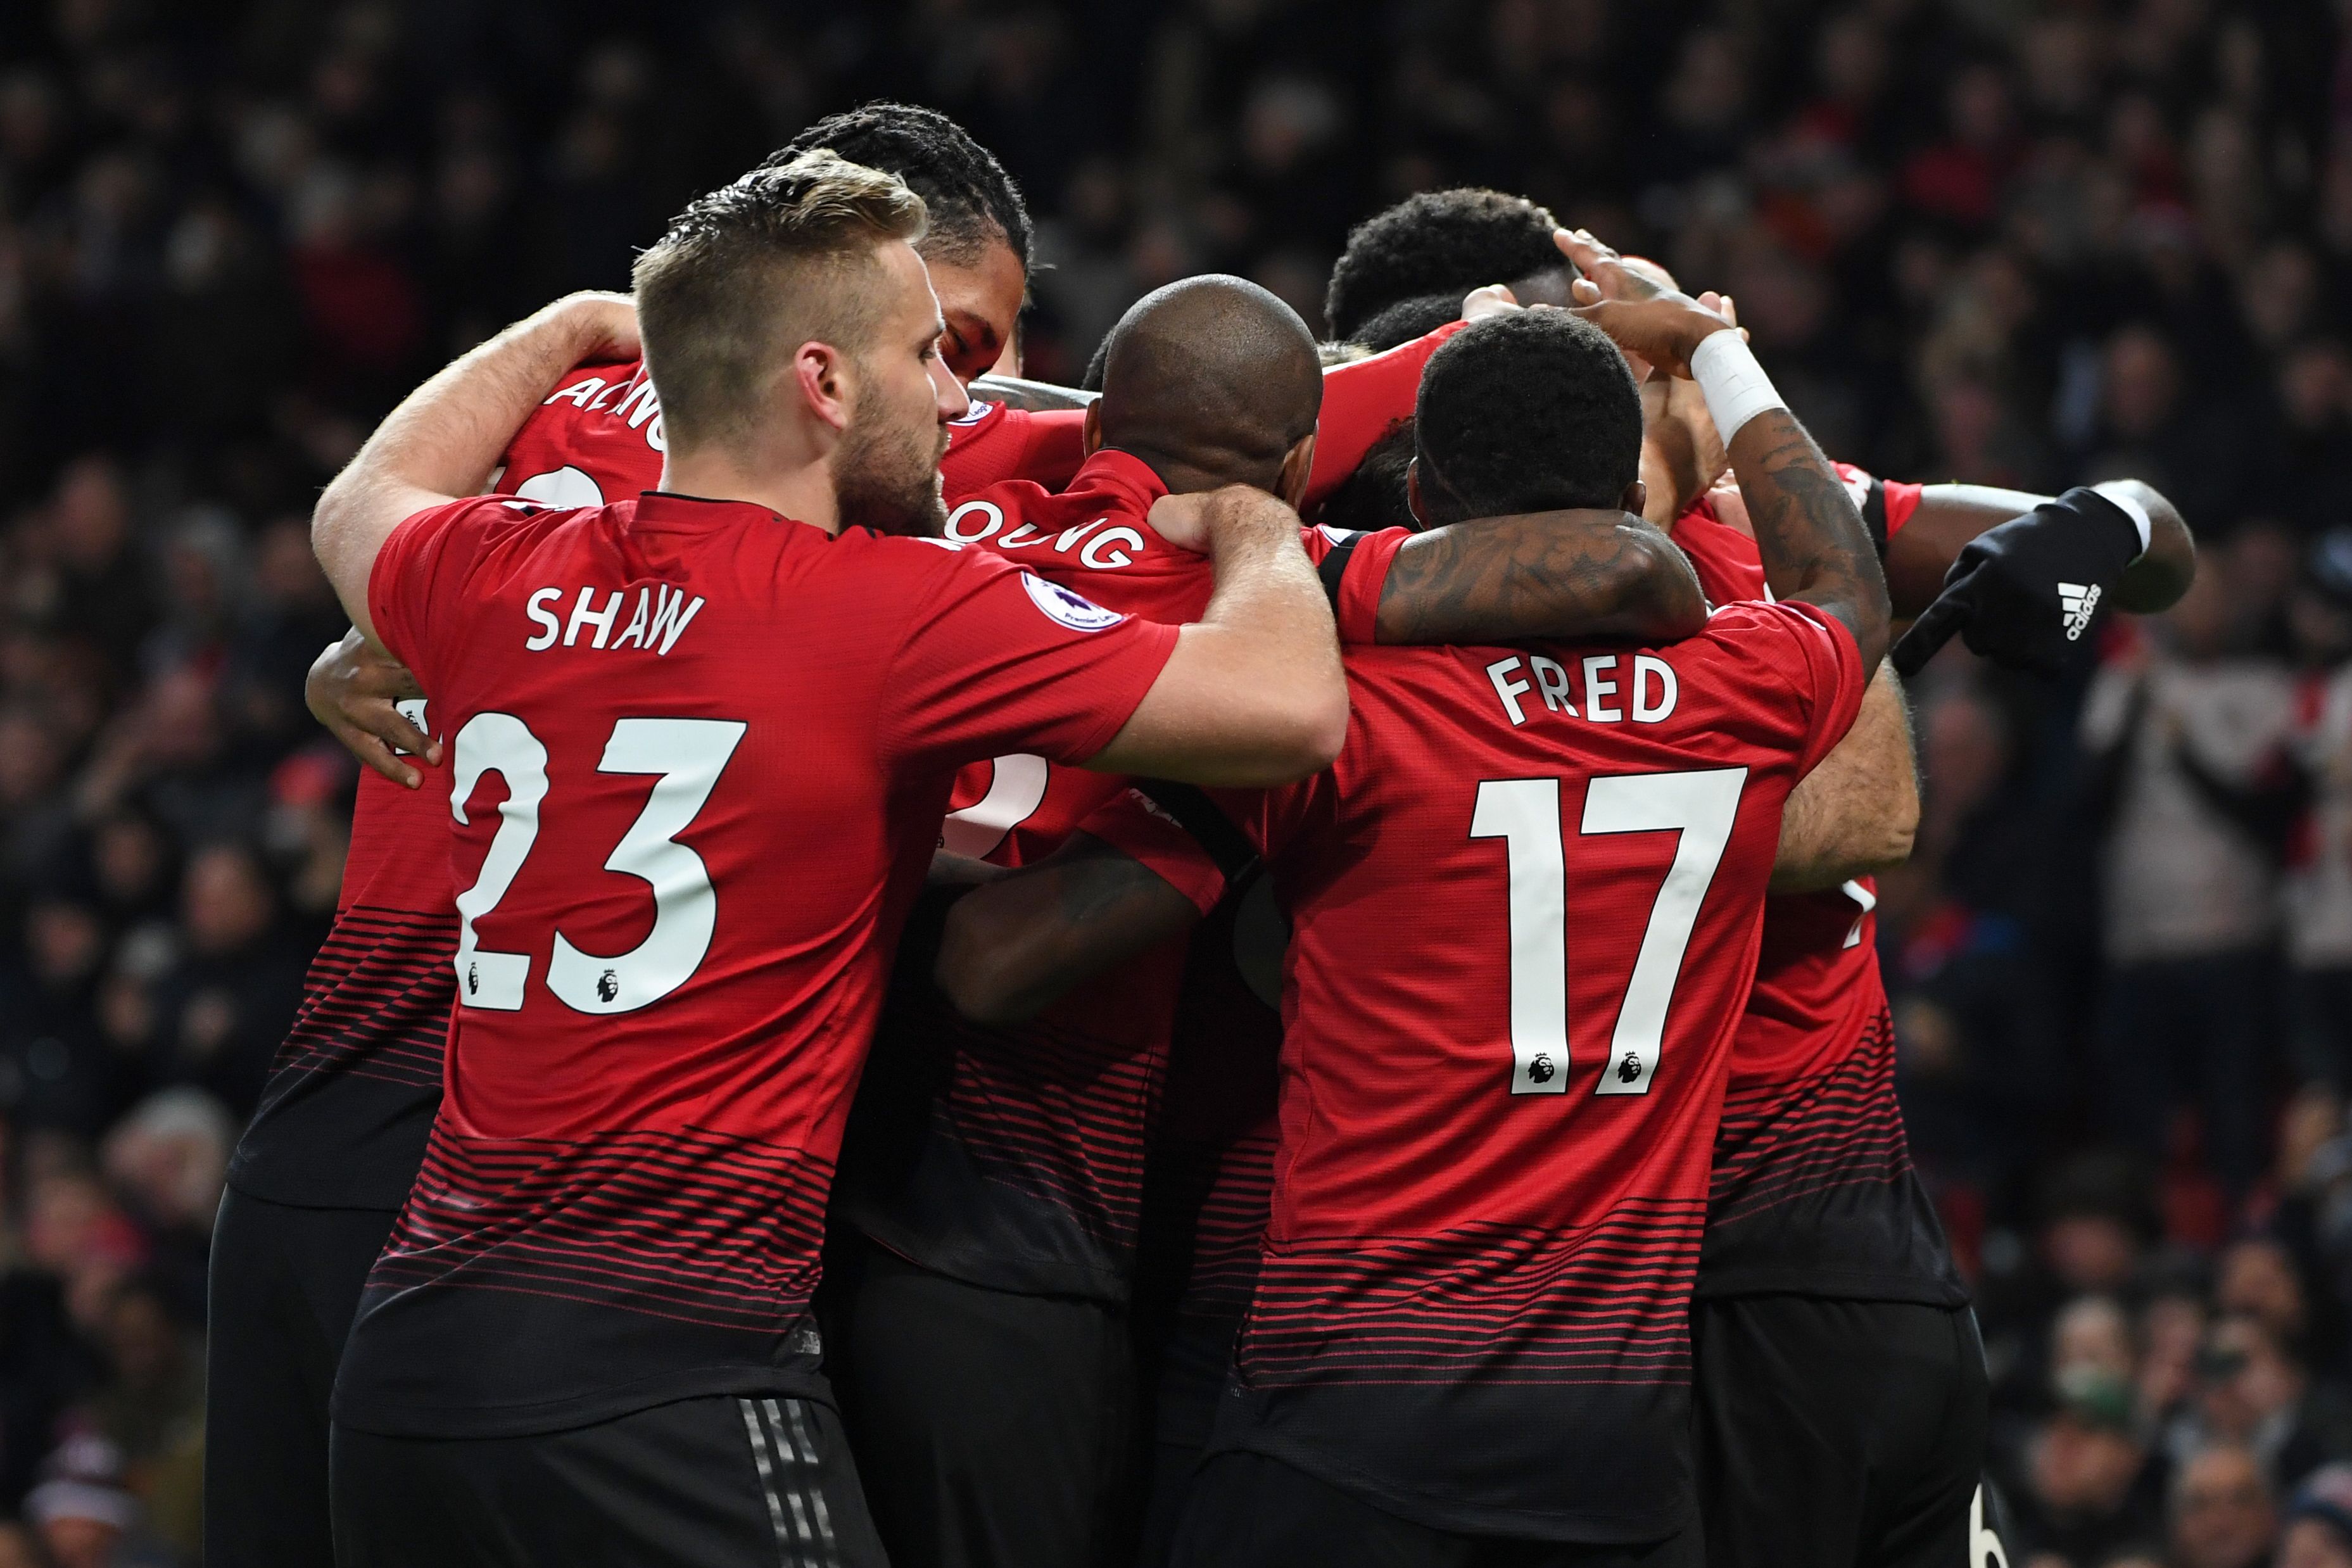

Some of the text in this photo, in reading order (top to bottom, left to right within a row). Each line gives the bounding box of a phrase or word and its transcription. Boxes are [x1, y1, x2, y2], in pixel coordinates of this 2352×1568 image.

[525, 583, 706, 656] SHAW
[2066, 583, 2102, 642] adidas
[1486, 654, 1679, 726] FRED
[450, 711, 749, 1016] 23
[1469, 766, 1750, 1096] 17
